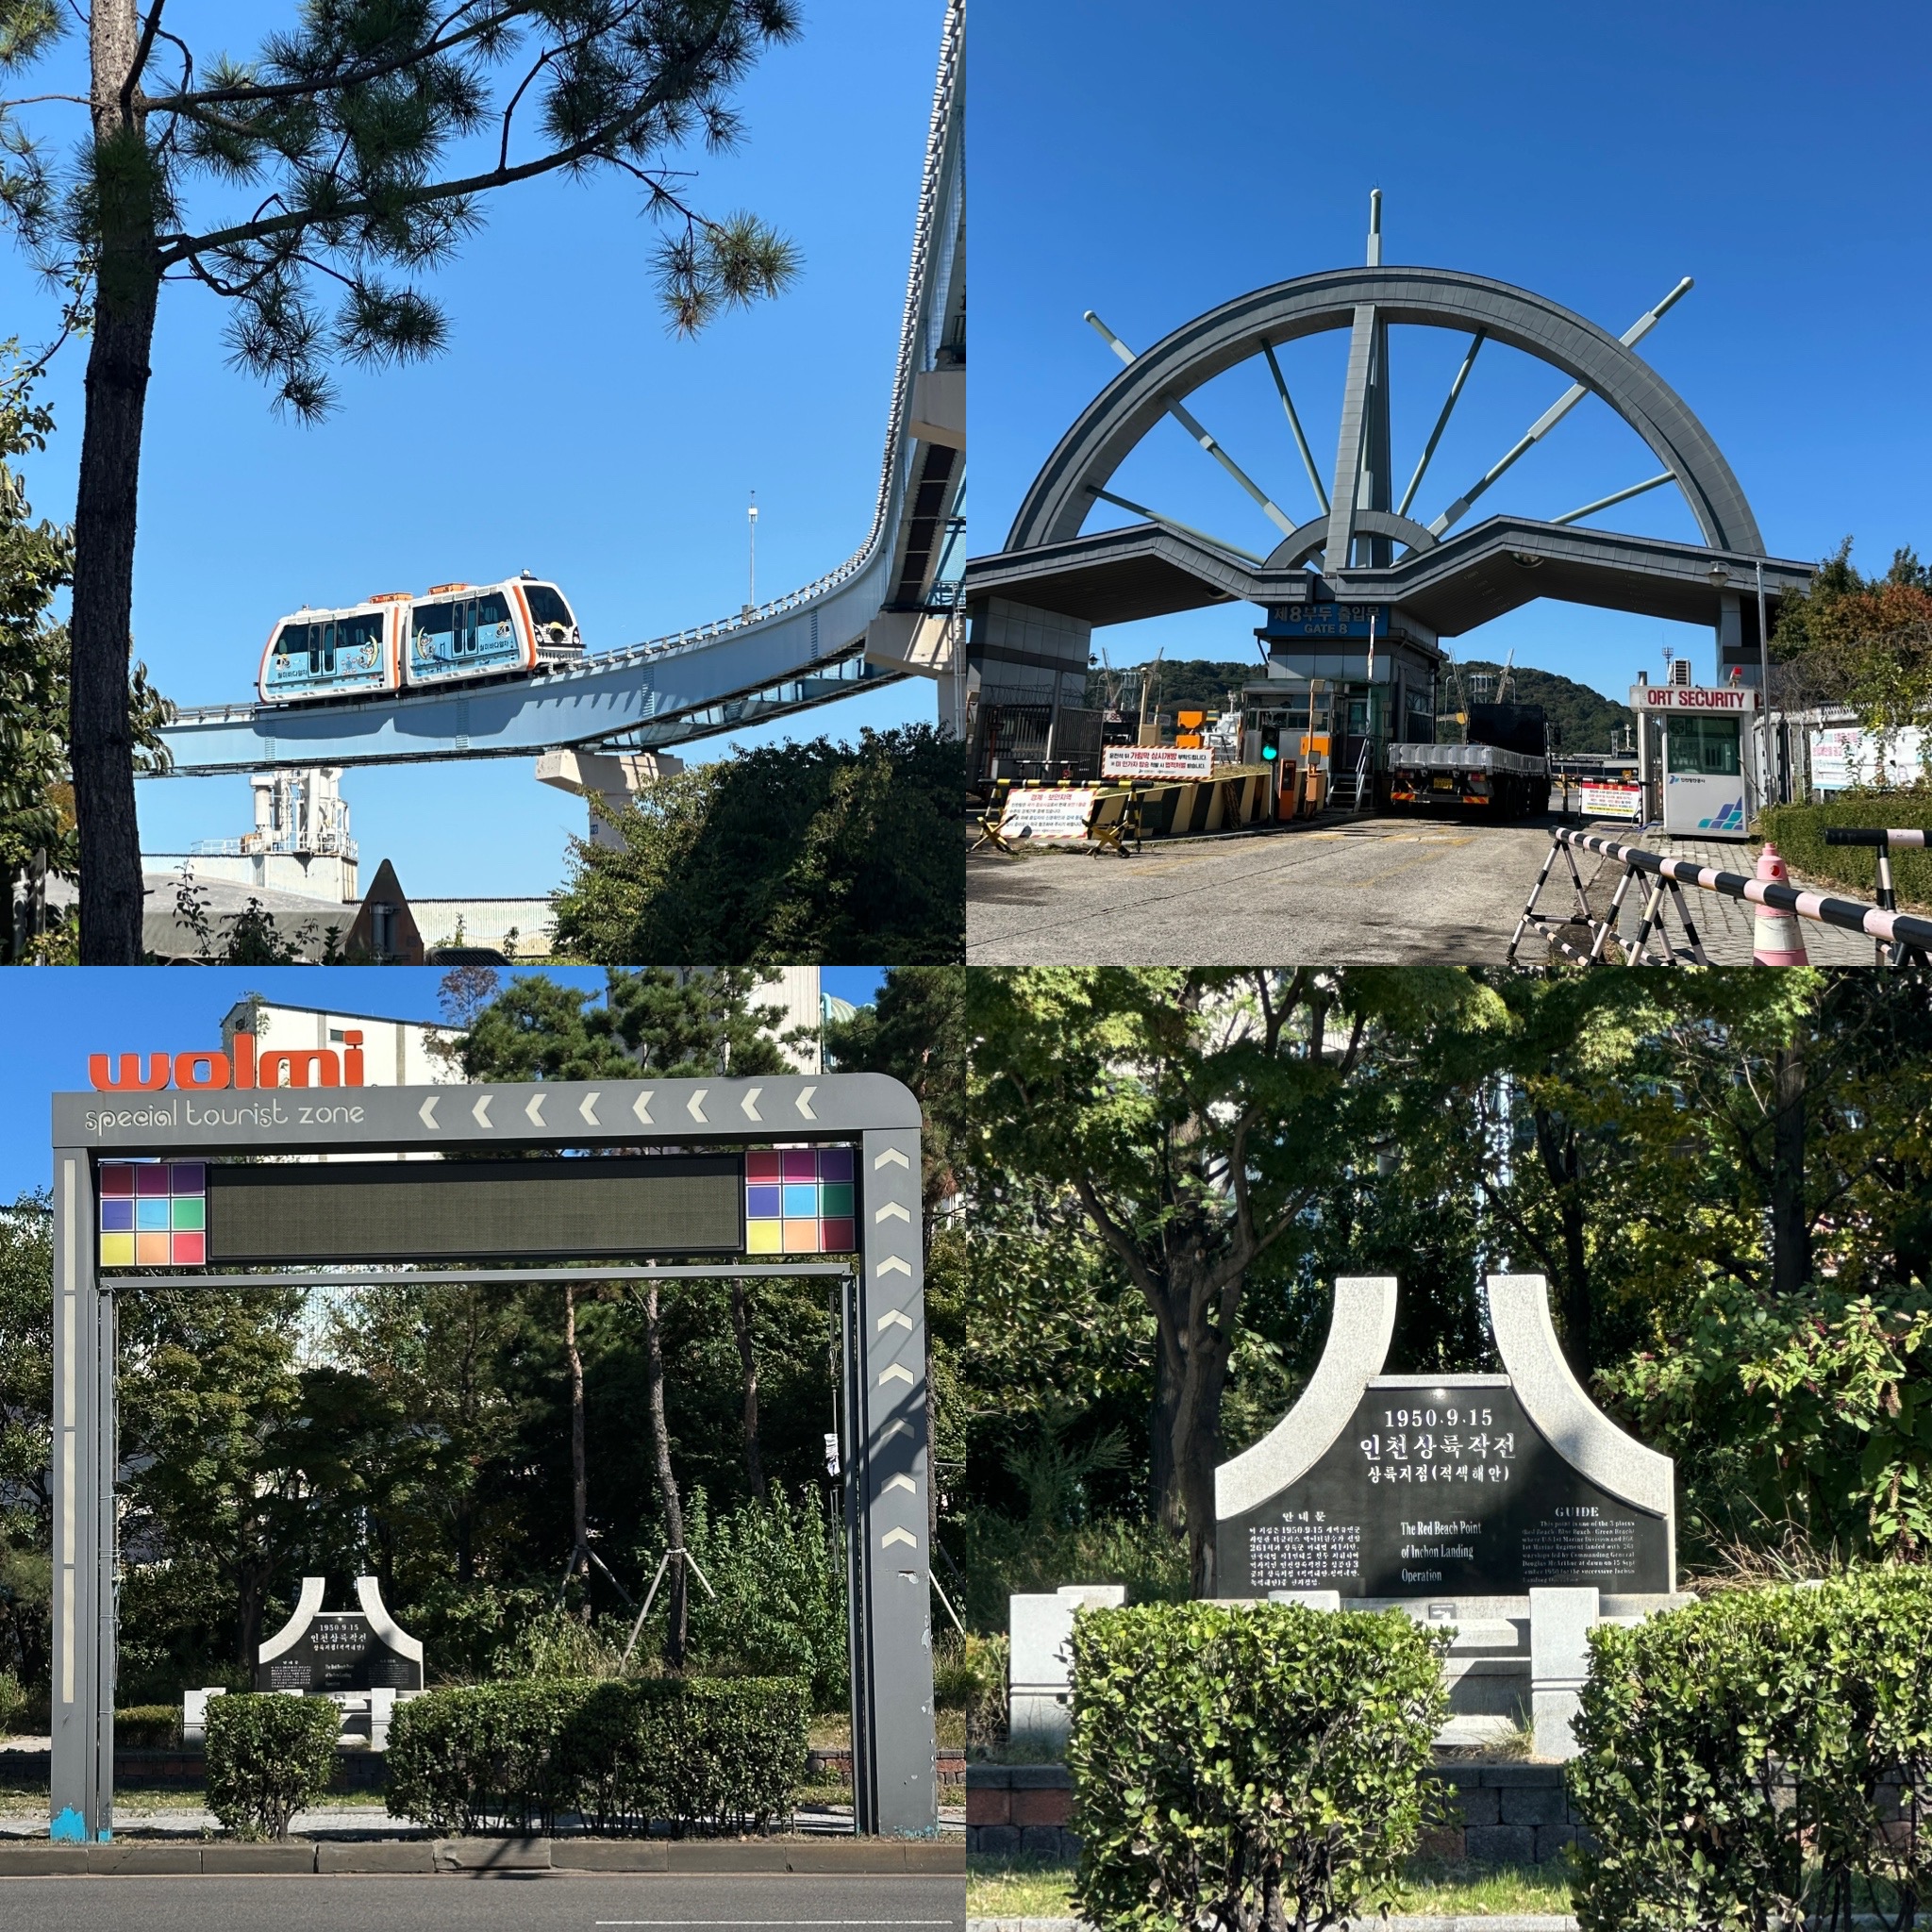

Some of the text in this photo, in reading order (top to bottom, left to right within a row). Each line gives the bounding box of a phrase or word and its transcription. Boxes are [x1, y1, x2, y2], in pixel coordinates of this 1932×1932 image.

[1274, 606, 1381, 623] 제8부두 출입문
[1305, 625, 1347, 634] GATE 8
[1679, 691, 1744, 708] SECURITY
[90, 1031, 364, 1091] wolmi
[85, 1097, 365, 1136] special tourist zone
[1360, 1433, 1516, 1460] 인천상륙작전
[1555, 1507, 1599, 1517] GUIDE
[1401, 1521, 1482, 1536] The Red Beach Point
[1401, 1544, 1474, 1560] of Inchon Landing
[1402, 1568, 1442, 1584] Operation
